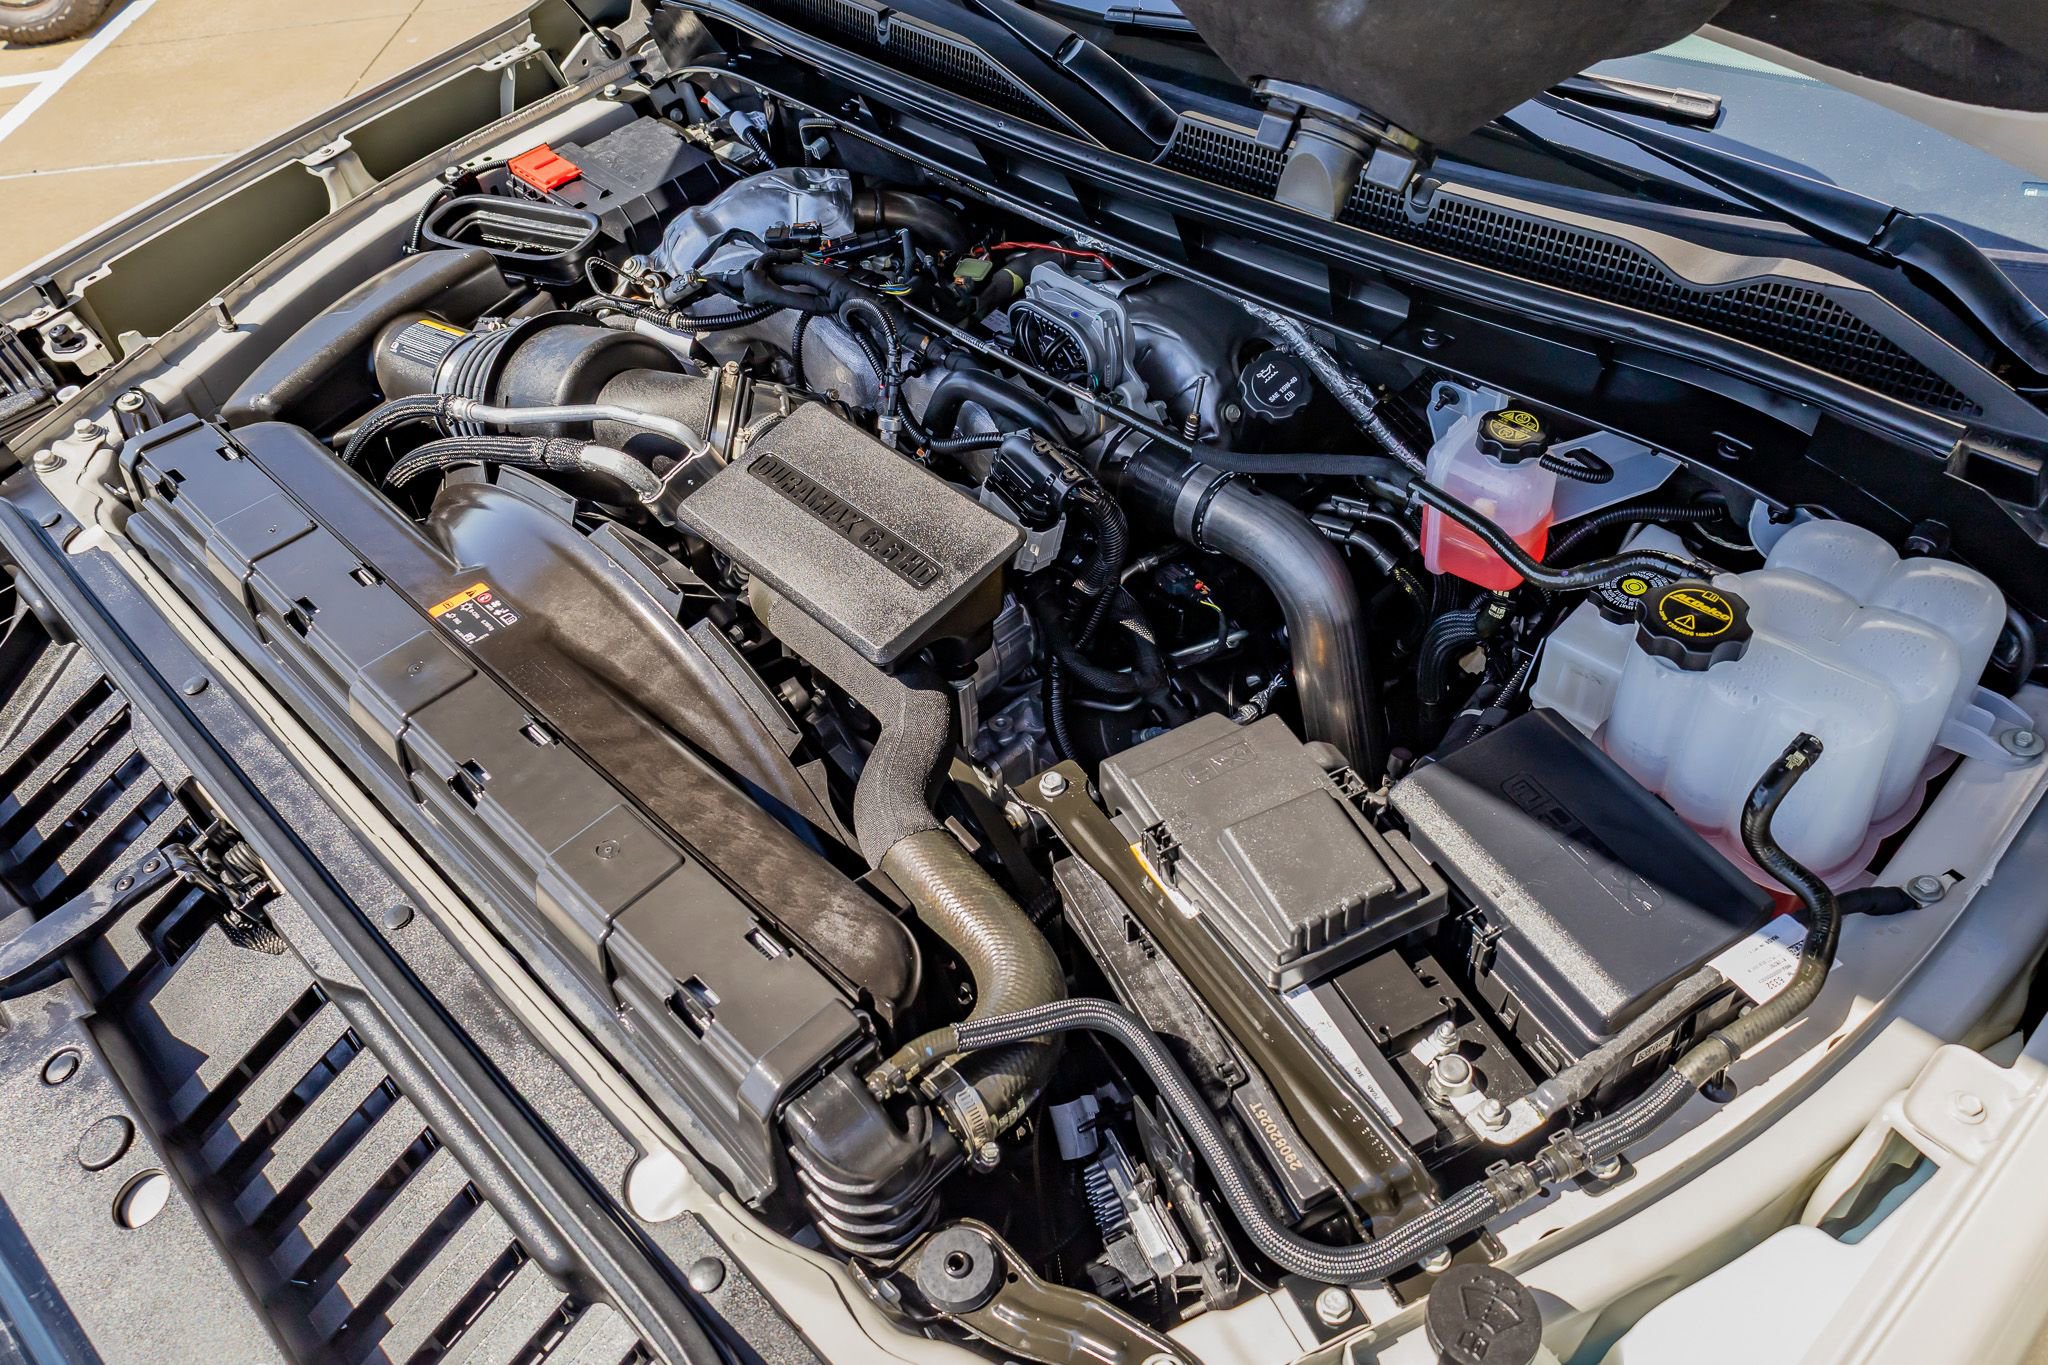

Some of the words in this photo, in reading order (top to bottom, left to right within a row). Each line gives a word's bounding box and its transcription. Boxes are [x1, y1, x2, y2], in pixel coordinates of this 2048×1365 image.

[1268, 391, 1280, 403] SAE
[756, 460, 864, 535] DURAMAX
[858, 527, 904, 563] 6.6
[895, 552, 939, 586] HD
[1671, 593, 1731, 620] ACDelco
[1367, 1085, 1380, 1100] 70Ah
[1249, 1102, 1303, 1171] 29082025T
